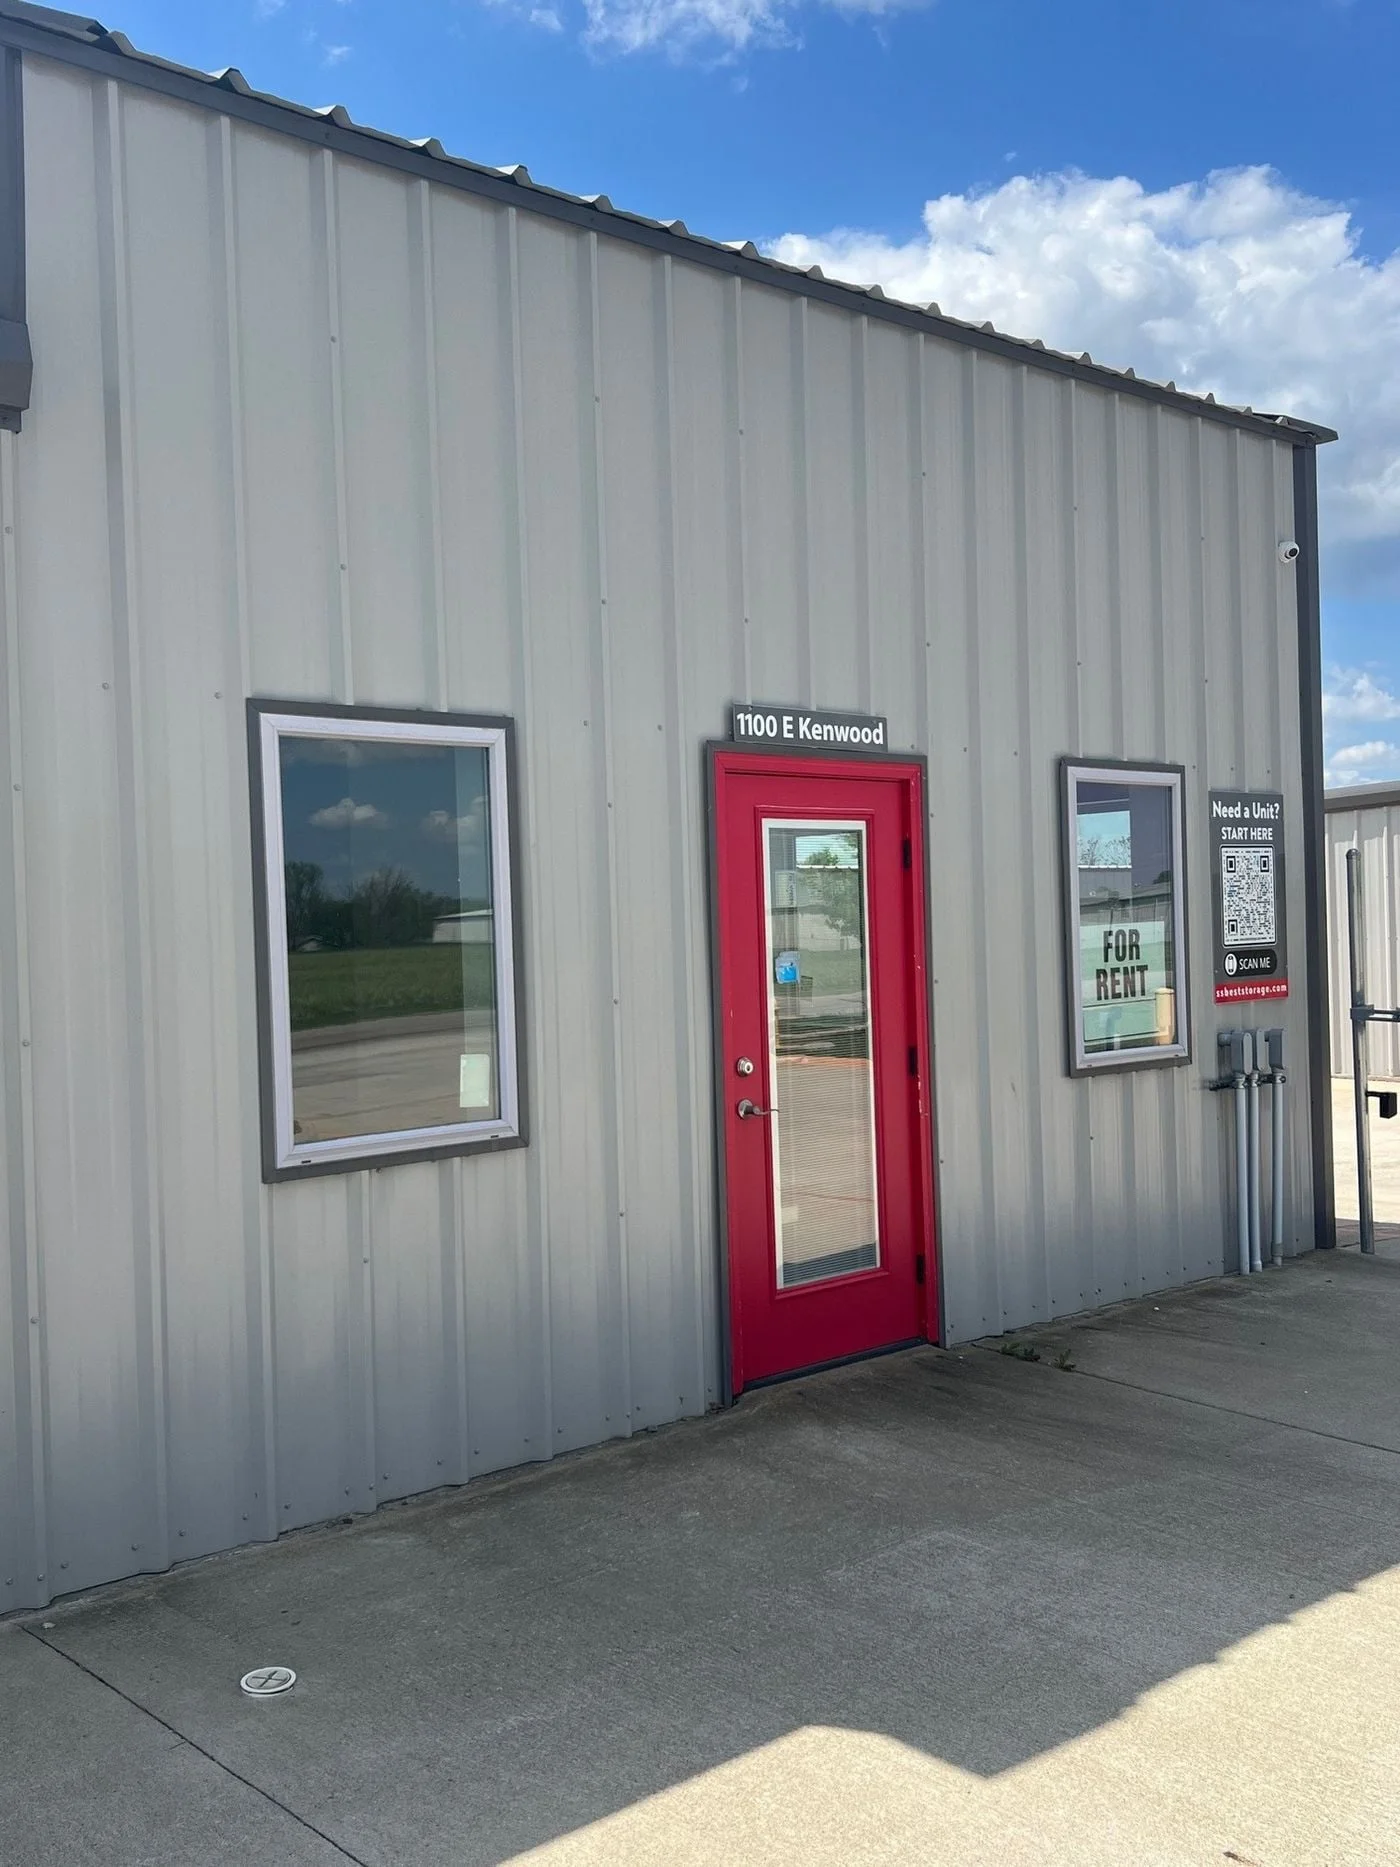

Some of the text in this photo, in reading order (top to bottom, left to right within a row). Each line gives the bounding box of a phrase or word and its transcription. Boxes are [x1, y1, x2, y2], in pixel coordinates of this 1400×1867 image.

[736, 713, 884, 745] 1100 E Kenwood
[1212, 801, 1280, 819] Need a Unit?
[1221, 827, 1273, 840] START HERE
[1103, 928, 1141, 963] FOR
[1239, 957, 1271, 970] SCAN ME
[1095, 964, 1149, 1001] RENT
[1216, 984, 1287, 998] ssbeststorage.com
